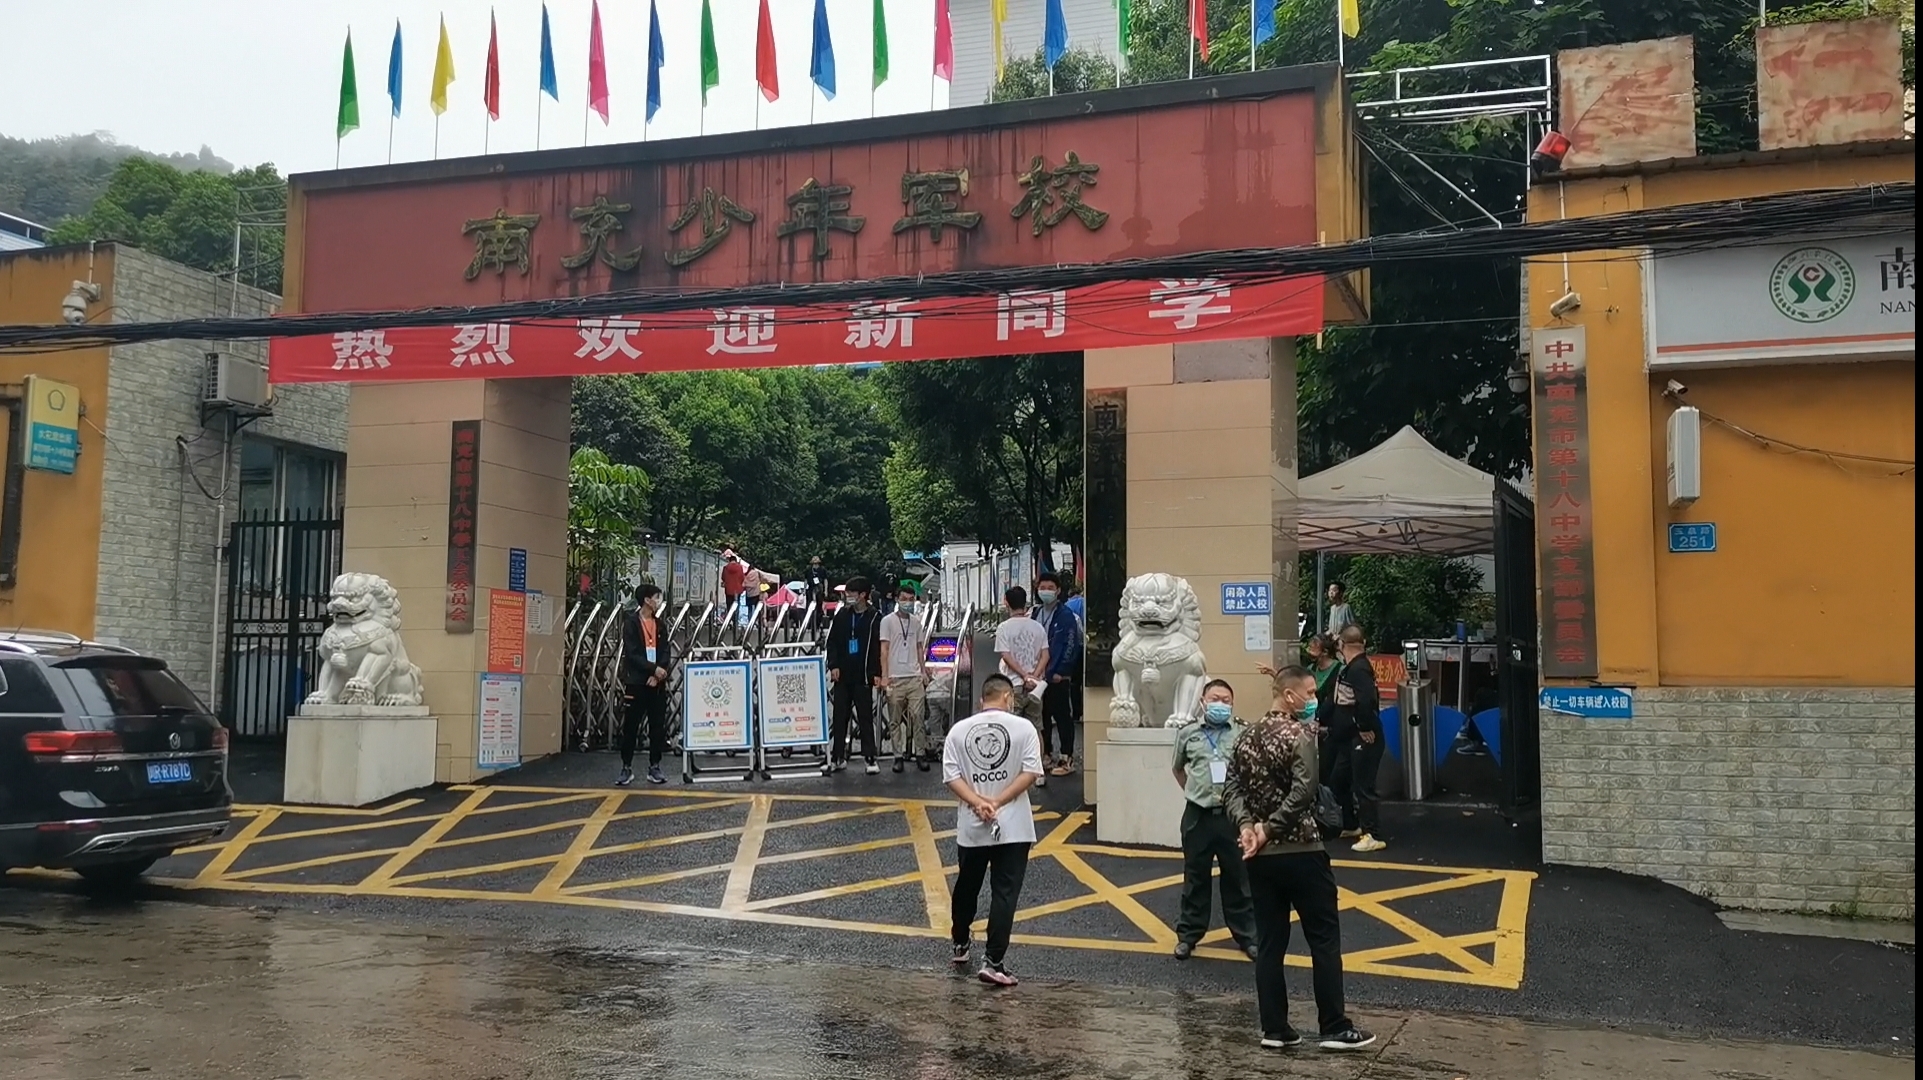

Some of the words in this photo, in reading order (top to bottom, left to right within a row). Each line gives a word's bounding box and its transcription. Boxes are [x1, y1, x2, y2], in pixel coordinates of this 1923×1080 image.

[461, 152, 1110, 281] 南充少年军校
[331, 277, 1232, 371] 热烈欢迎新同学
[1679, 536, 1706, 547] 251
[1225, 586, 1268, 598] 闲杂人员
[1225, 598, 1268, 610] 禁止入校
[1543, 694, 1629, 709] 禁止一切车辆进入校园
[972, 770, 1008, 784] ROCCO
